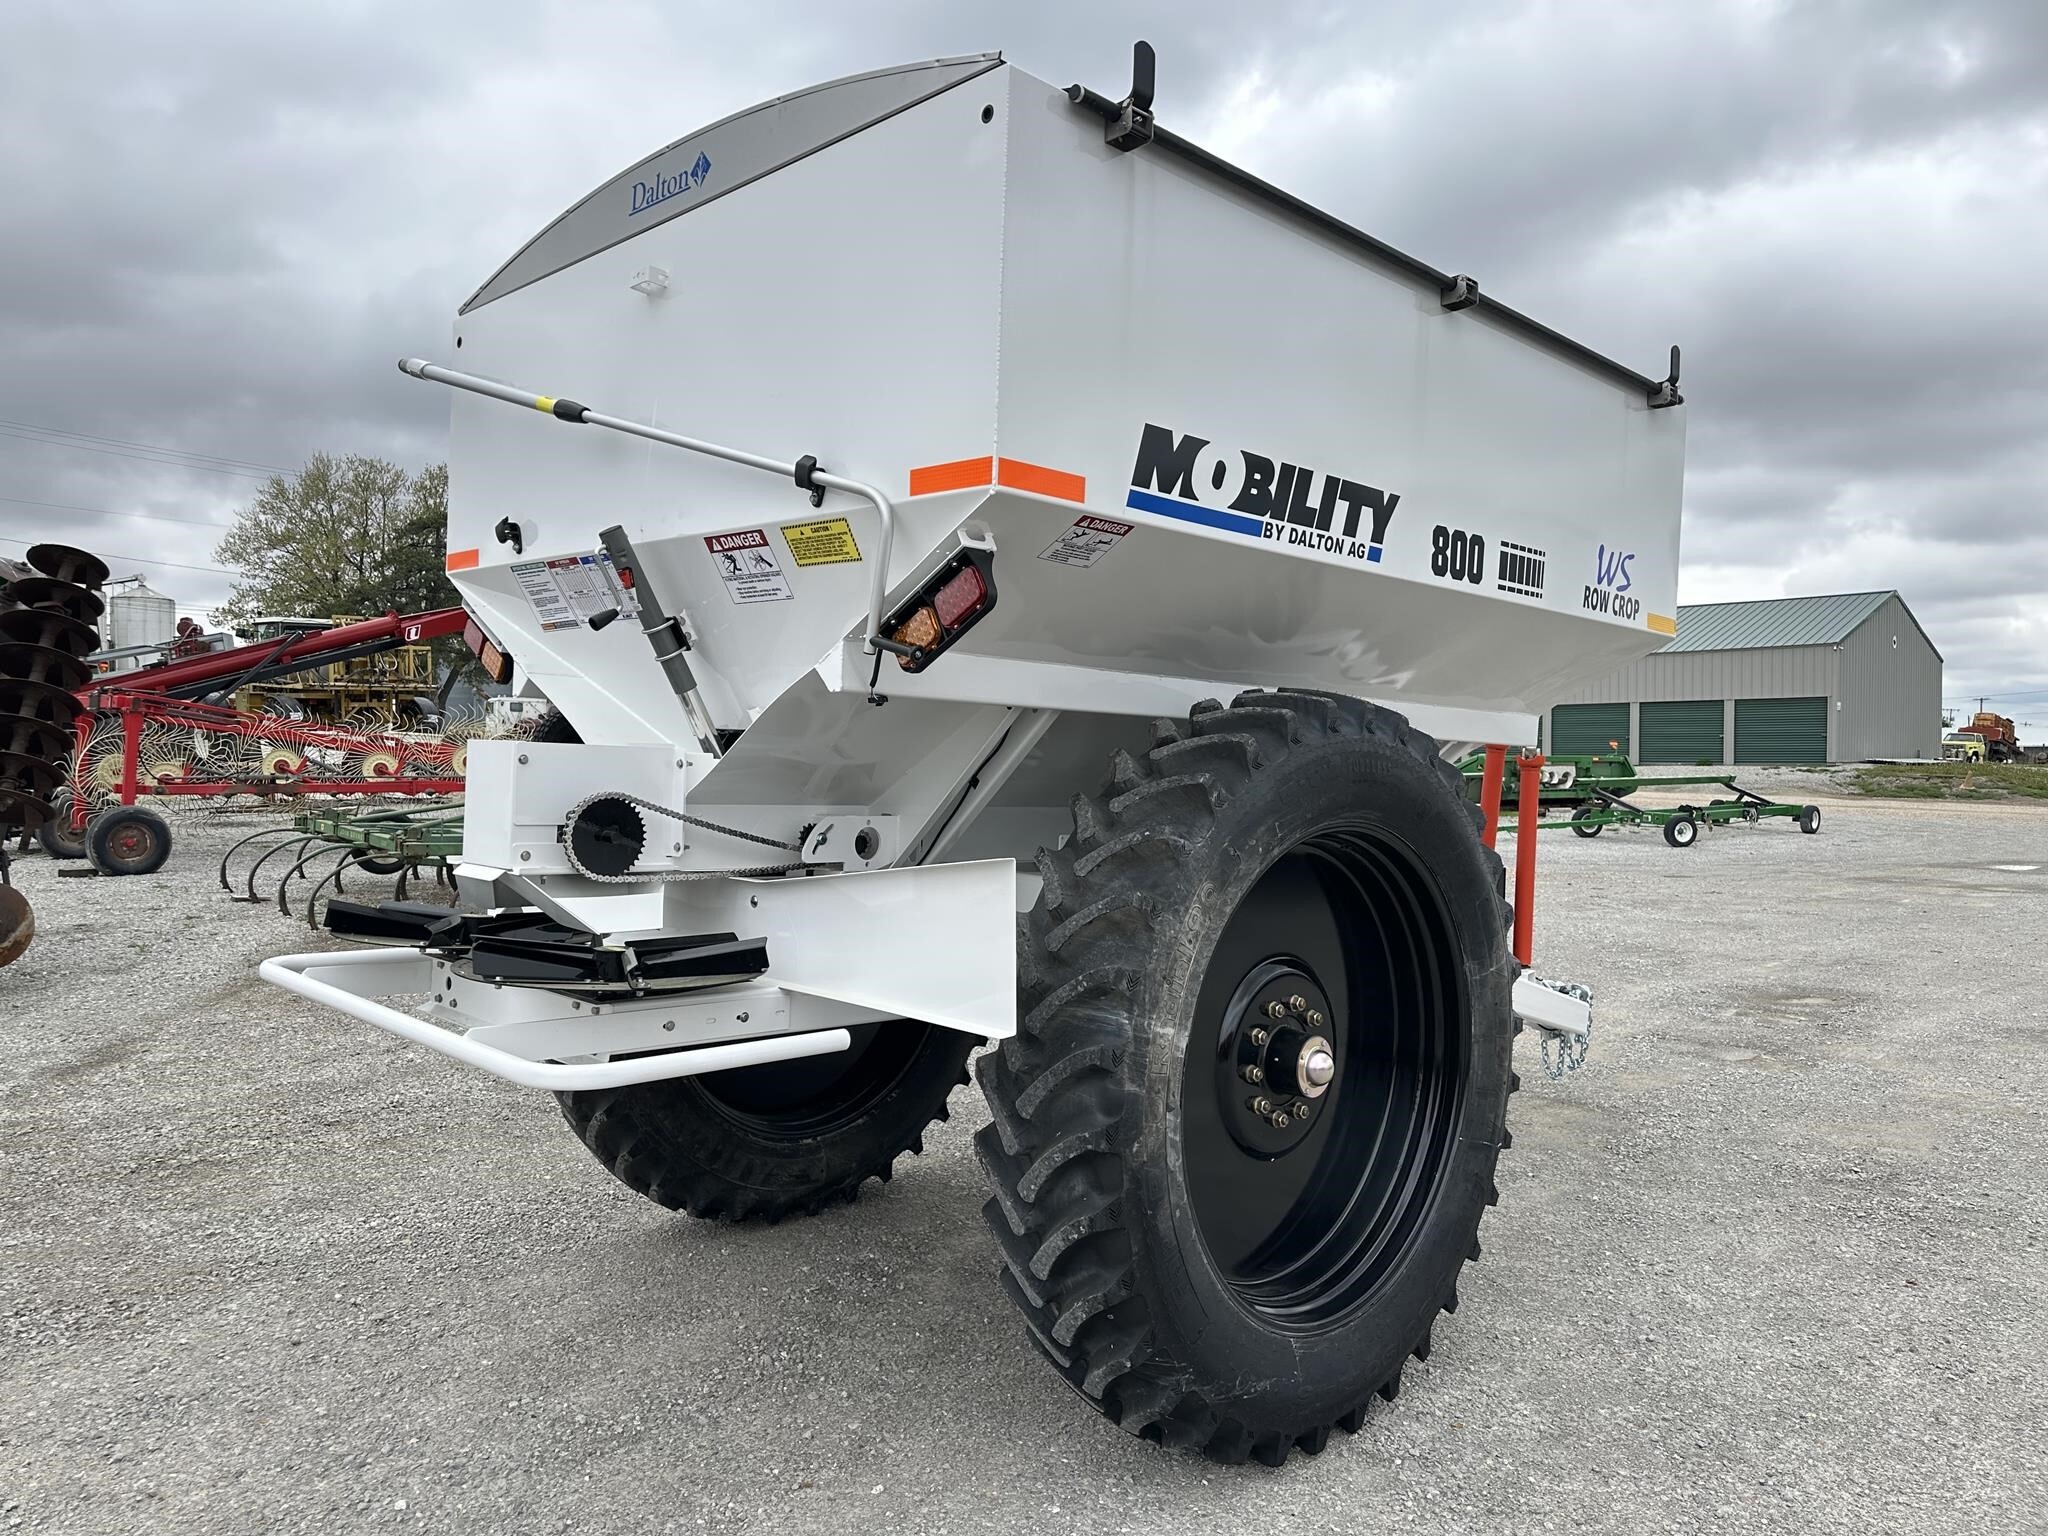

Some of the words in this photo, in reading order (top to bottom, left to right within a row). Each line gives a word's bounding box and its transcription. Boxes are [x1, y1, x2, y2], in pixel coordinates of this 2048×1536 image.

[632, 170, 689, 211] Dalton
[1131, 423, 1401, 545] MOBILITY
[719, 532, 764, 549] DANGER
[1088, 519, 1129, 534] DANGER
[1262, 521, 1286, 541] BY
[1288, 527, 1345, 555] DALTON
[1347, 541, 1366, 560] AG
[1431, 524, 1485, 585] 800
[1597, 543, 1635, 592] WS
[1582, 584, 1610, 613] ROW
[1612, 593, 1640, 621] CROP
